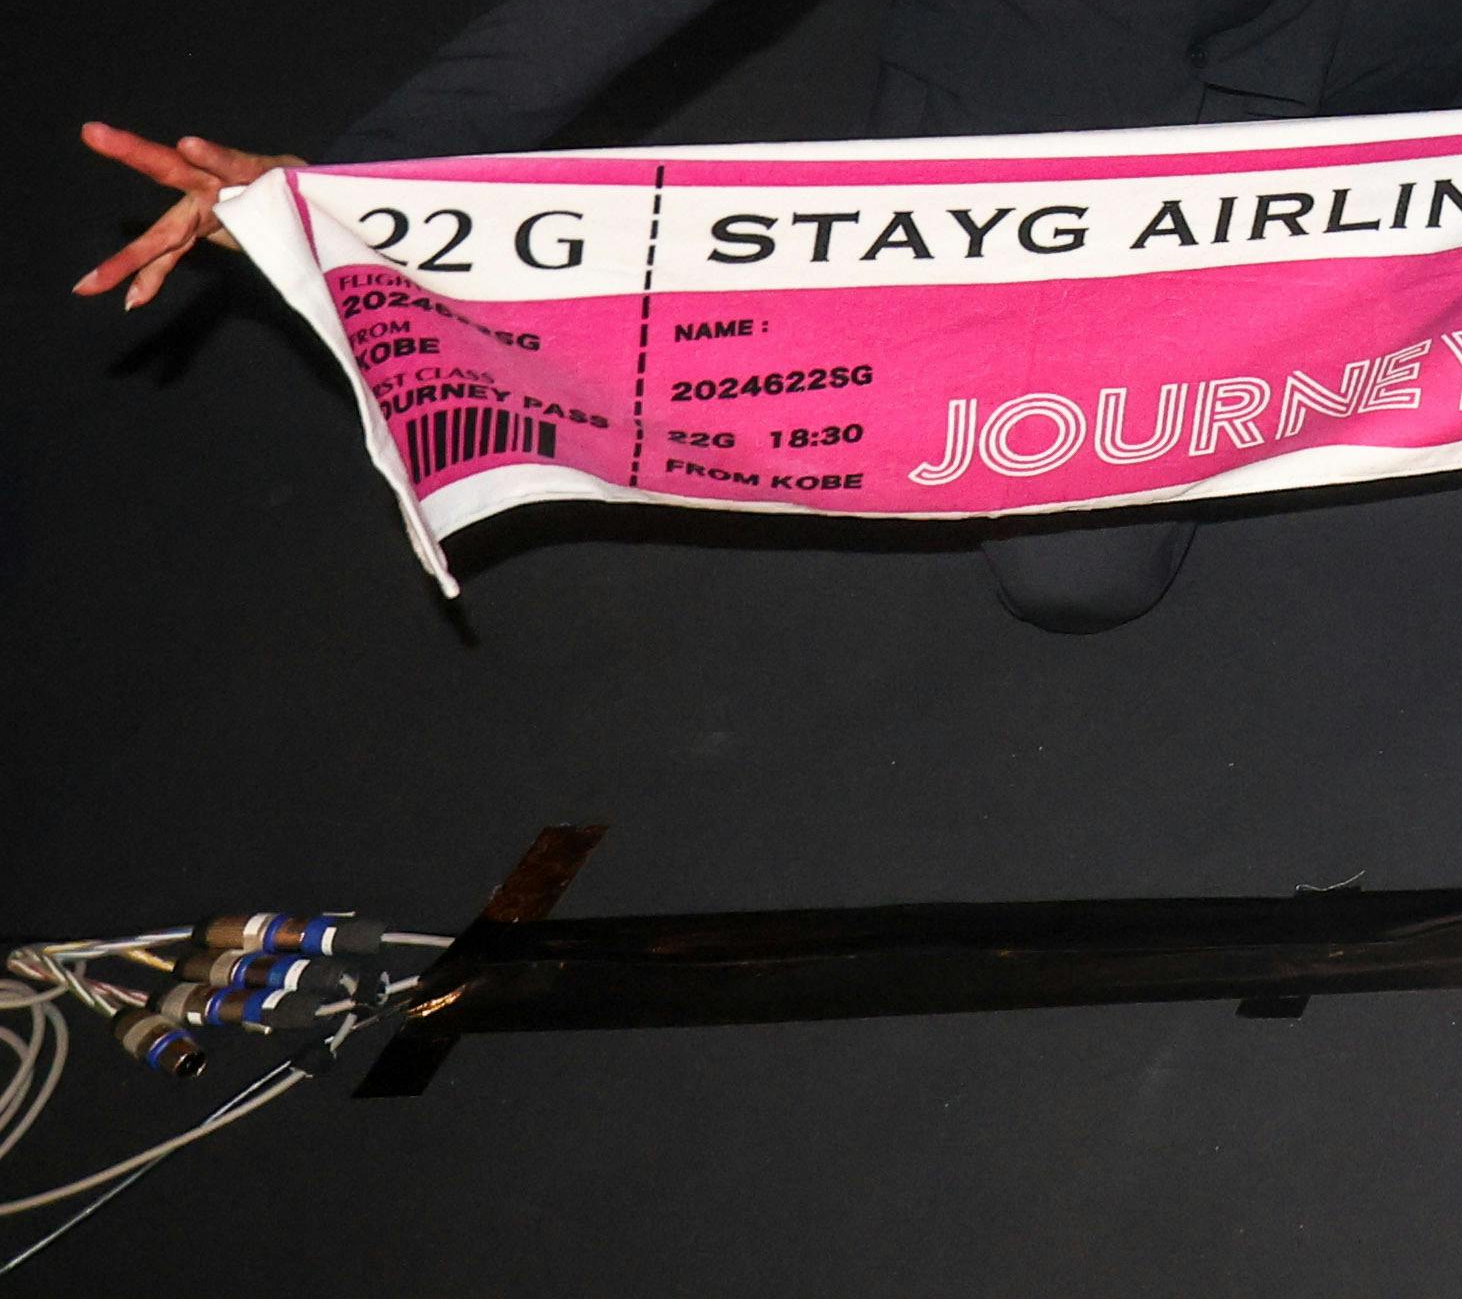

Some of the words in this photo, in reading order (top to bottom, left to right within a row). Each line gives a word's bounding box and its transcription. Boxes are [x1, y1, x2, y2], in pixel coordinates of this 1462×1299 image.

[357, 207, 474, 273] 22
[514, 210, 585, 270] G
[706, 205, 1091, 265] STAYG
[355, 337, 441, 372] KOBE
[670, 365, 874, 403] 2024622SG
[379, 383, 511, 421] OURNEY
[522, 396, 610, 430] PASS
[667, 430, 736, 449] 22G
[770, 423, 864, 450] 18:30
[665, 459, 759, 487] FROM
[771, 473, 864, 491] KOBE
